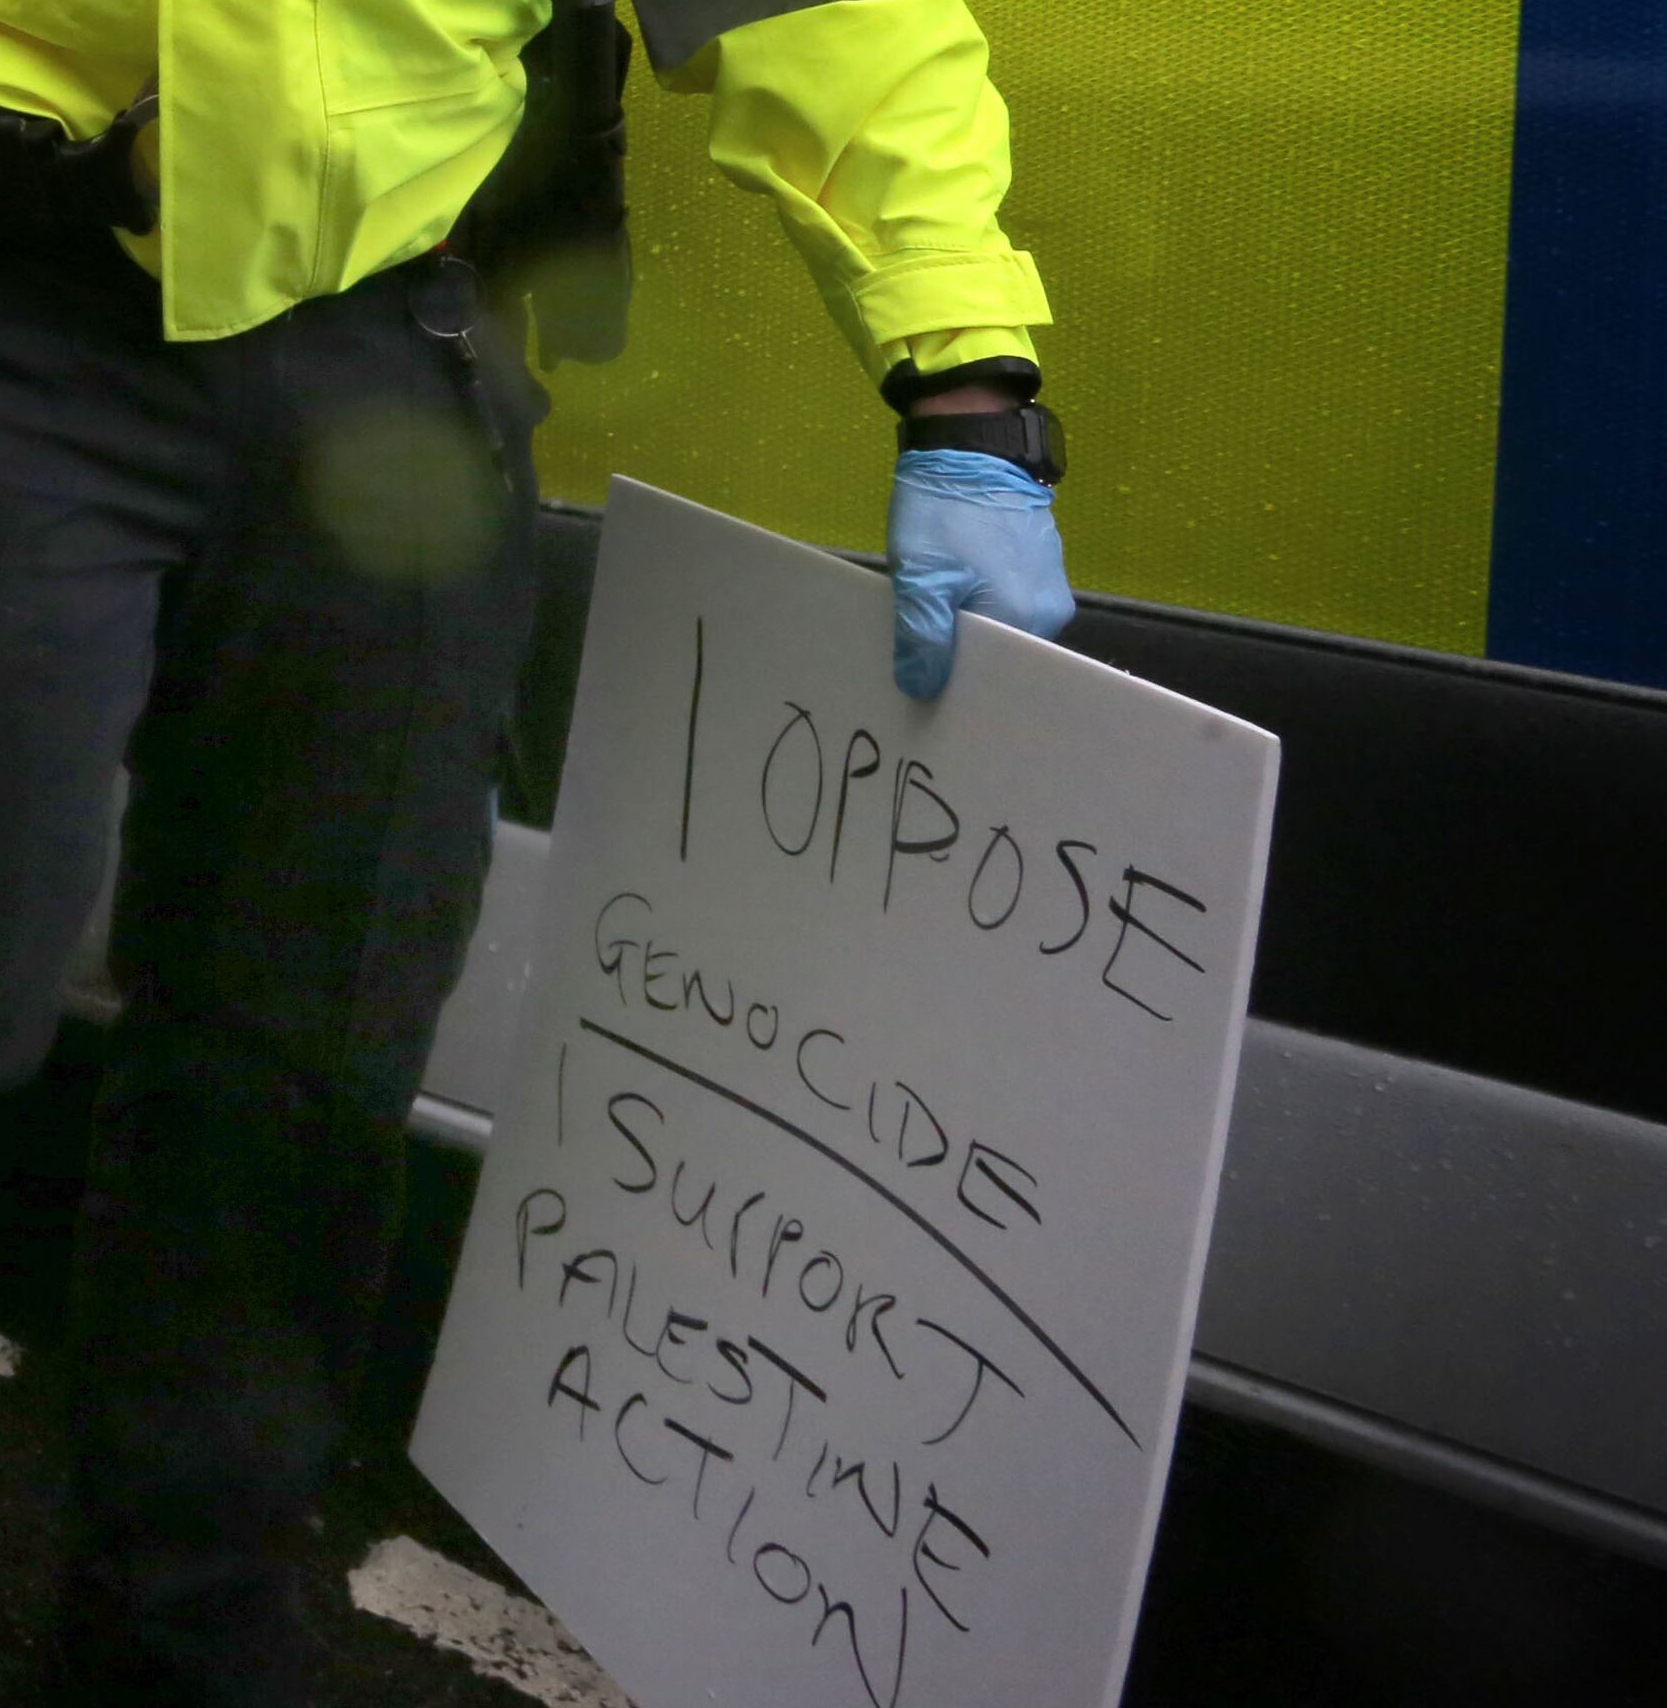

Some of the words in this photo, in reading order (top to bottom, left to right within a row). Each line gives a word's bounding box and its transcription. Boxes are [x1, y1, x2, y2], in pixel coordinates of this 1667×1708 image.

[759, 700, 1208, 1022] OPPOSE
[594, 892, 1043, 1230] GENOCIDE
[515, 1188, 992, 1632] PALESTINE
[606, 1093, 1025, 1446] SUPPORT
[547, 1345, 909, 1708] ACTION
